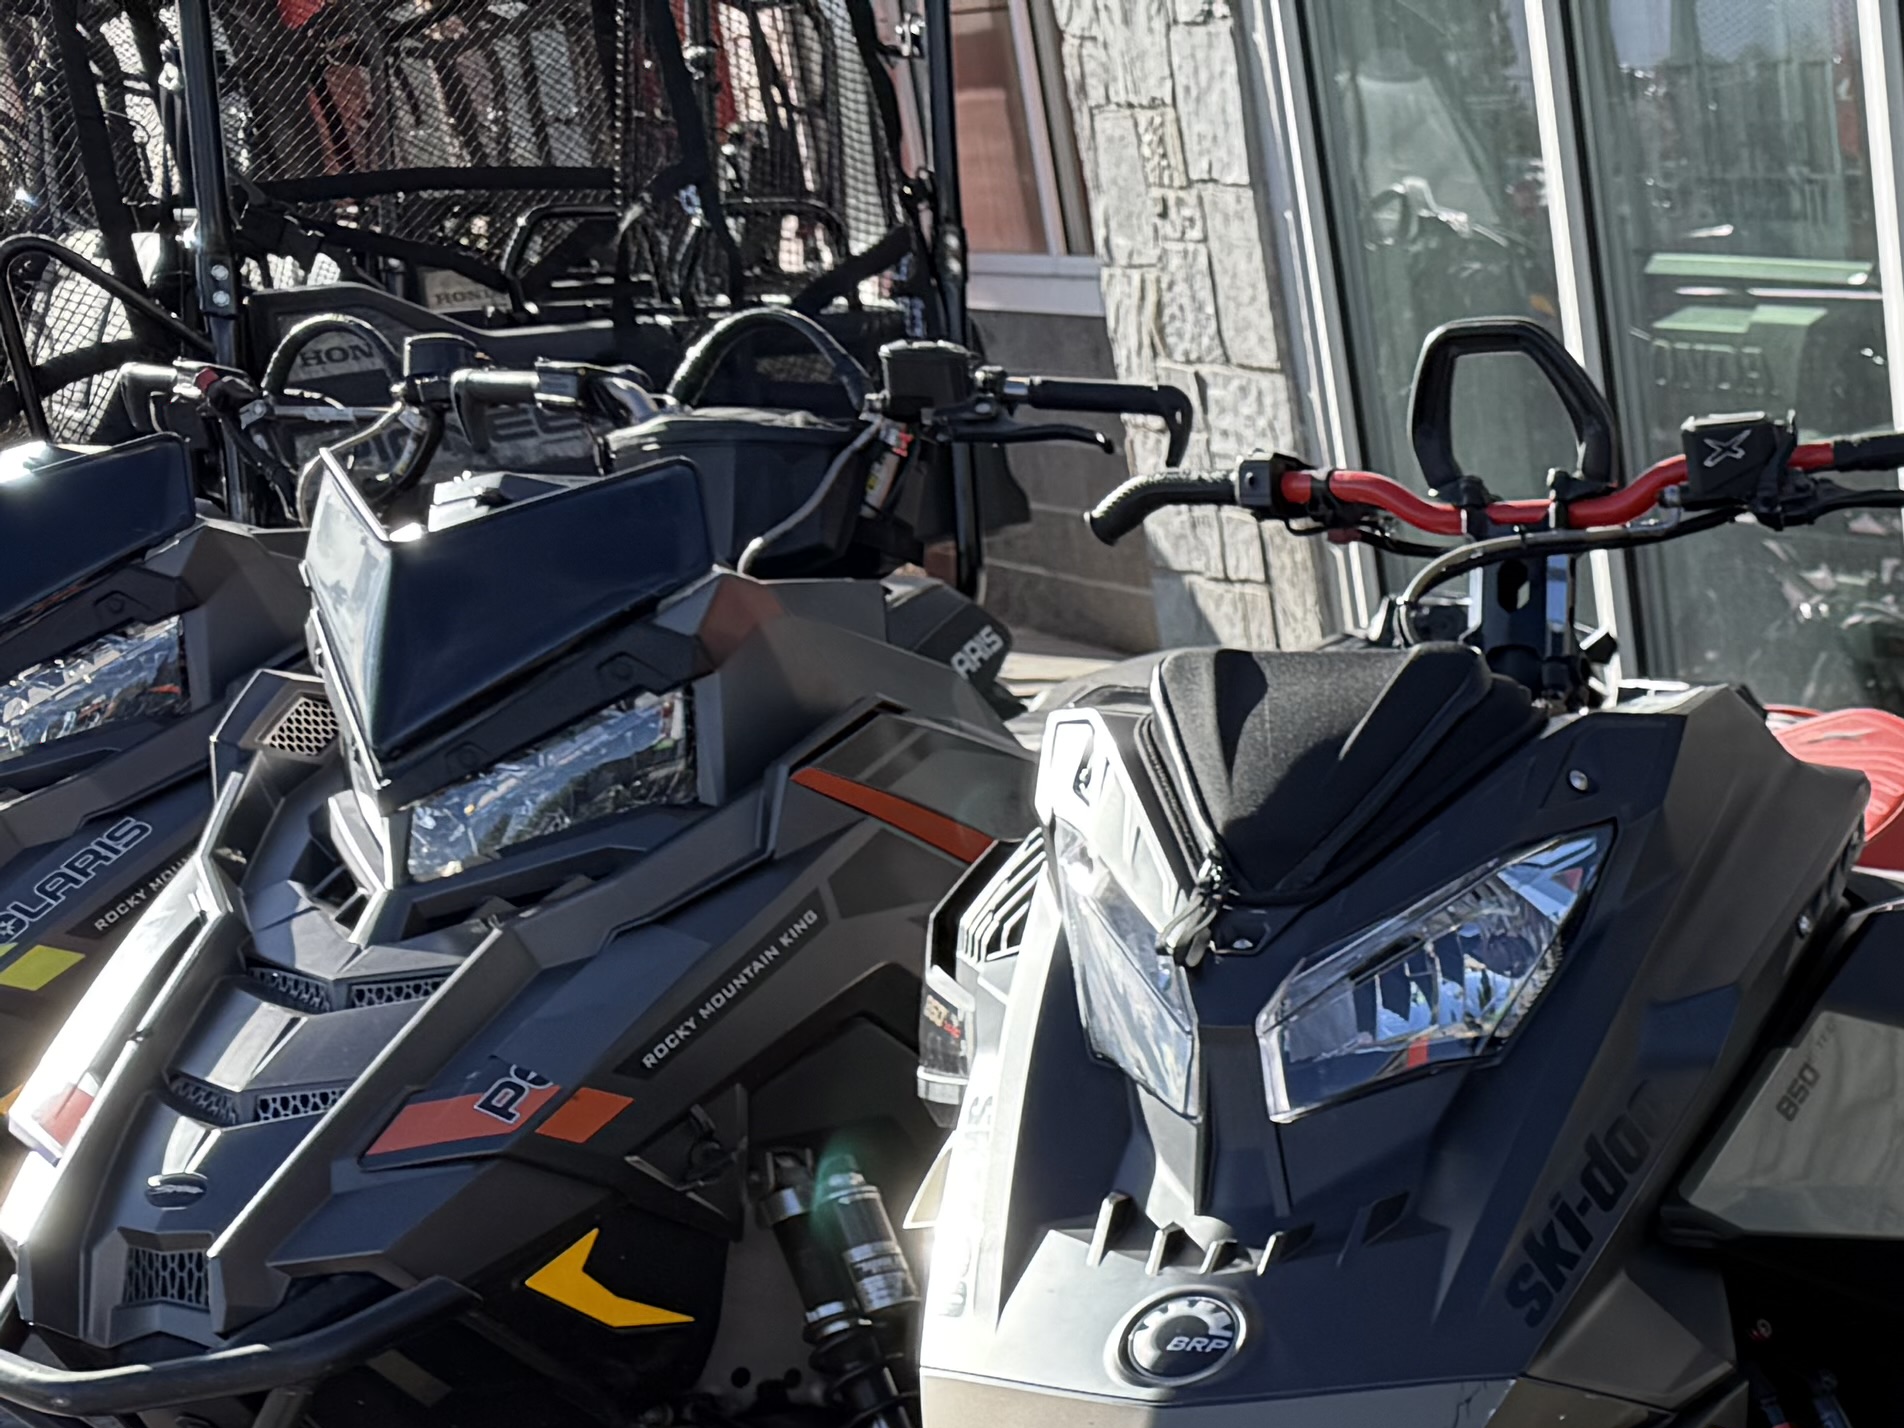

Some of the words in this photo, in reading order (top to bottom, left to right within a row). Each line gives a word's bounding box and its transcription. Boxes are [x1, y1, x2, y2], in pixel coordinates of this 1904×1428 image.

[302, 347, 376, 368] HON
[951, 624, 1004, 681] ARIS
[0, 816, 153, 943] OLARIS
[94, 887, 148, 932] ROCKY
[642, 1015, 697, 1069] ROCKY
[699, 945, 780, 1020] MOUNTAIN
[779, 909, 818, 947] KING
[1776, 1061, 1821, 1122] 850
[1166, 1336, 1229, 1352] BRP
